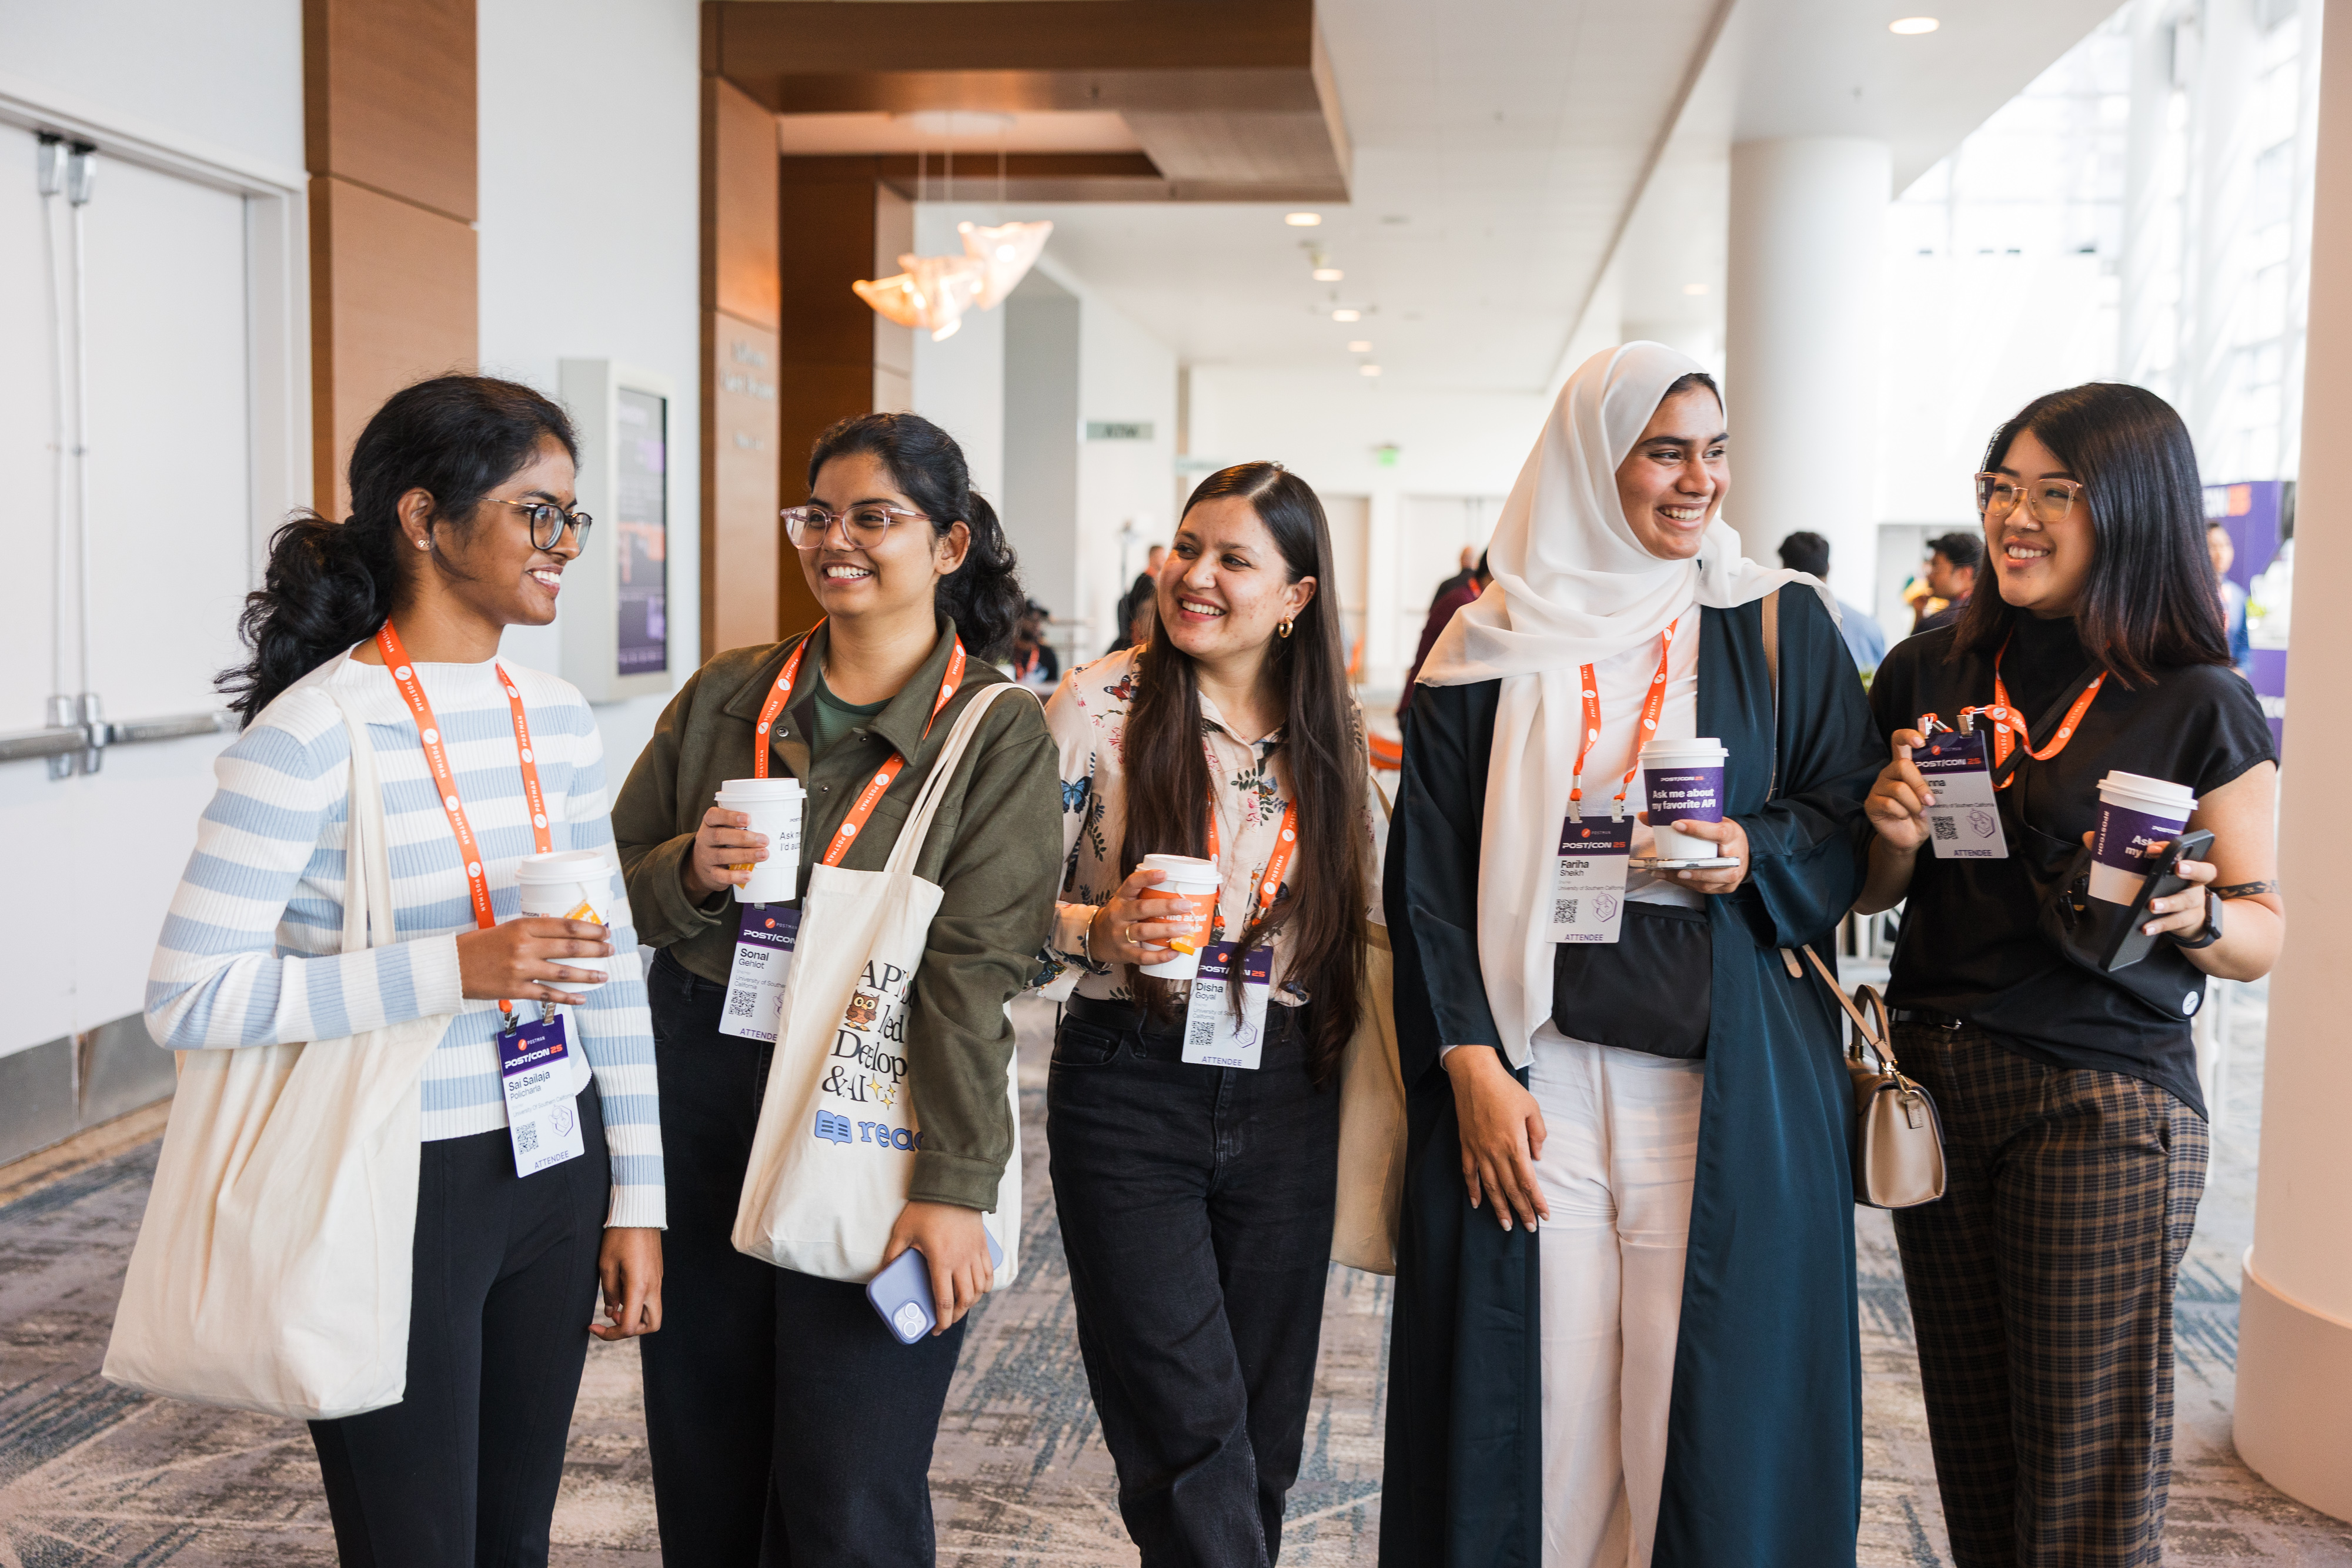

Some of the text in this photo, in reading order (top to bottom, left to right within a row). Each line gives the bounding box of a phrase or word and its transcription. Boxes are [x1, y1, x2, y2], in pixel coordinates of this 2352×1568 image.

[382, 628, 395, 653] POSTMAN
[786, 658, 799, 680] POSTMAN
[405, 681, 425, 711] POSTMAN
[766, 700, 779, 721] POSTMAN
[1588, 699, 1596, 718] POSTMAN
[1648, 696, 1658, 718] POSTMAN
[2067, 701, 2084, 726] POSTMAN
[517, 716, 527, 747] POSTMAN
[432, 745, 447, 778] POSTMAN
[1915, 759, 1966, 767] POST/CON
[530, 780, 541, 812] POSTMAN
[860, 786, 878, 811] POSTMAN
[1653, 790, 1668, 798] Ask
[1686, 788, 1714, 797] about
[1652, 799, 1716, 811] my favorite API
[455, 813, 470, 845] POSTMAN
[780, 831, 794, 840] Ask
[827, 836, 846, 862] POSTMAN
[2124, 847, 2143, 858] my
[1270, 855, 1285, 882] POSTMAN
[1561, 860, 1589, 868] Fariha
[475, 879, 486, 912] POSTMAN
[1183, 914, 1208, 922] about
[739, 958, 765, 969] Gehlot
[740, 948, 769, 961] Sonal
[856, 959, 906, 998] API
[1198, 965, 1251, 976] POST/N
[734, 981, 757, 990] California
[736, 975, 760, 985] University
[767, 980, 786, 989] Souther
[1197, 982, 1223, 993] Disha
[1195, 992, 1216, 1000] Goyal
[877, 1005, 904, 1044] led
[527, 1036, 545, 1045] POSTMAN
[740, 1028, 777, 1041] ATTENDE
[505, 1044, 563, 1069] POST/CON 25
[831, 1029, 907, 1084] Deelop
[1201, 1056, 1242, 1066] ATTENDEE
[509, 1071, 550, 1091] Sai Sailaja
[510, 1085, 541, 1101] Policharla
[556, 1092, 574, 1102] California
[534, 1150, 569, 1169] ATTENDEE
